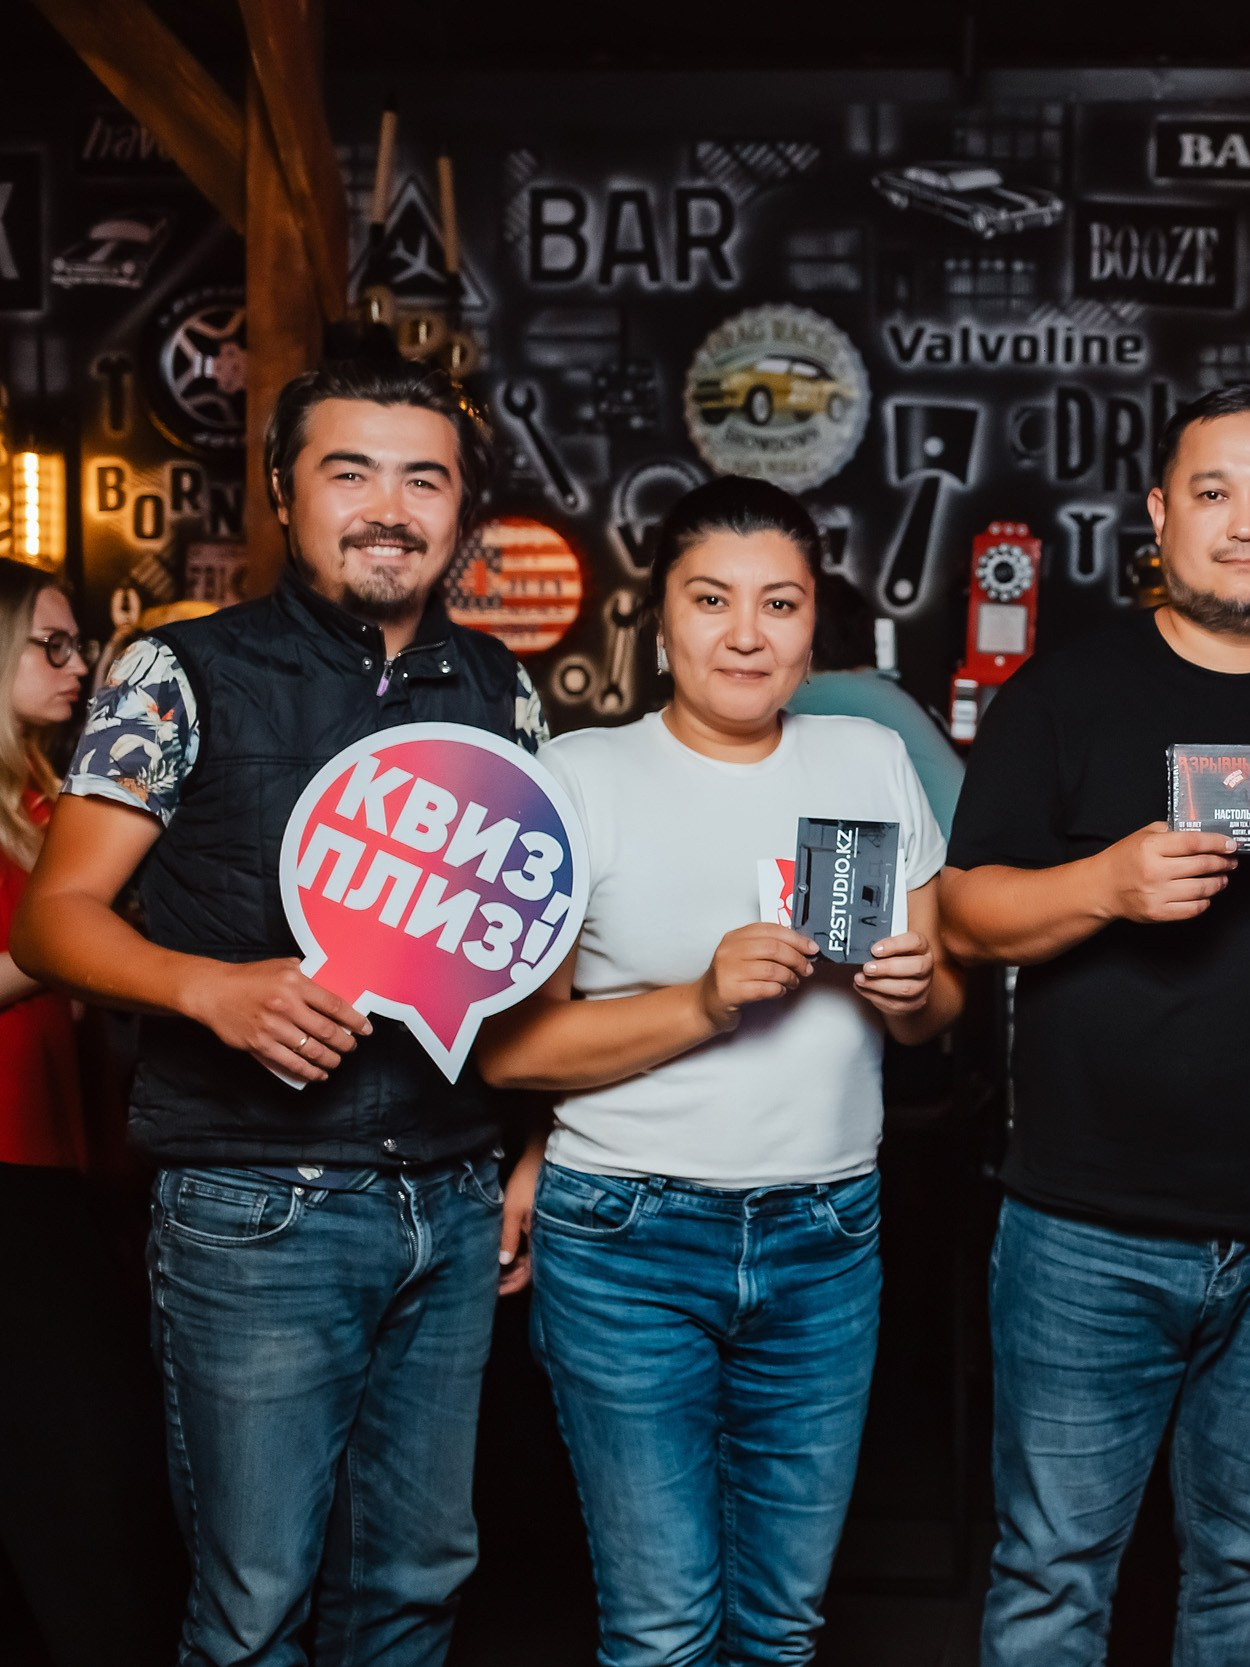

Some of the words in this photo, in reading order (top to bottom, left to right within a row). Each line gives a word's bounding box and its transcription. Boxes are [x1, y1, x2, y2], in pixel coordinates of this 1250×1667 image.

[527, 187, 738, 286] BAR
[1089, 222, 1219, 286] BOOZE
[886, 325, 1145, 365] Valvoline
[97, 465, 243, 541] BORN
[297, 822, 555, 984] ПЛИЗ!
[828, 829, 853, 952] F2STUDIO.KZ
